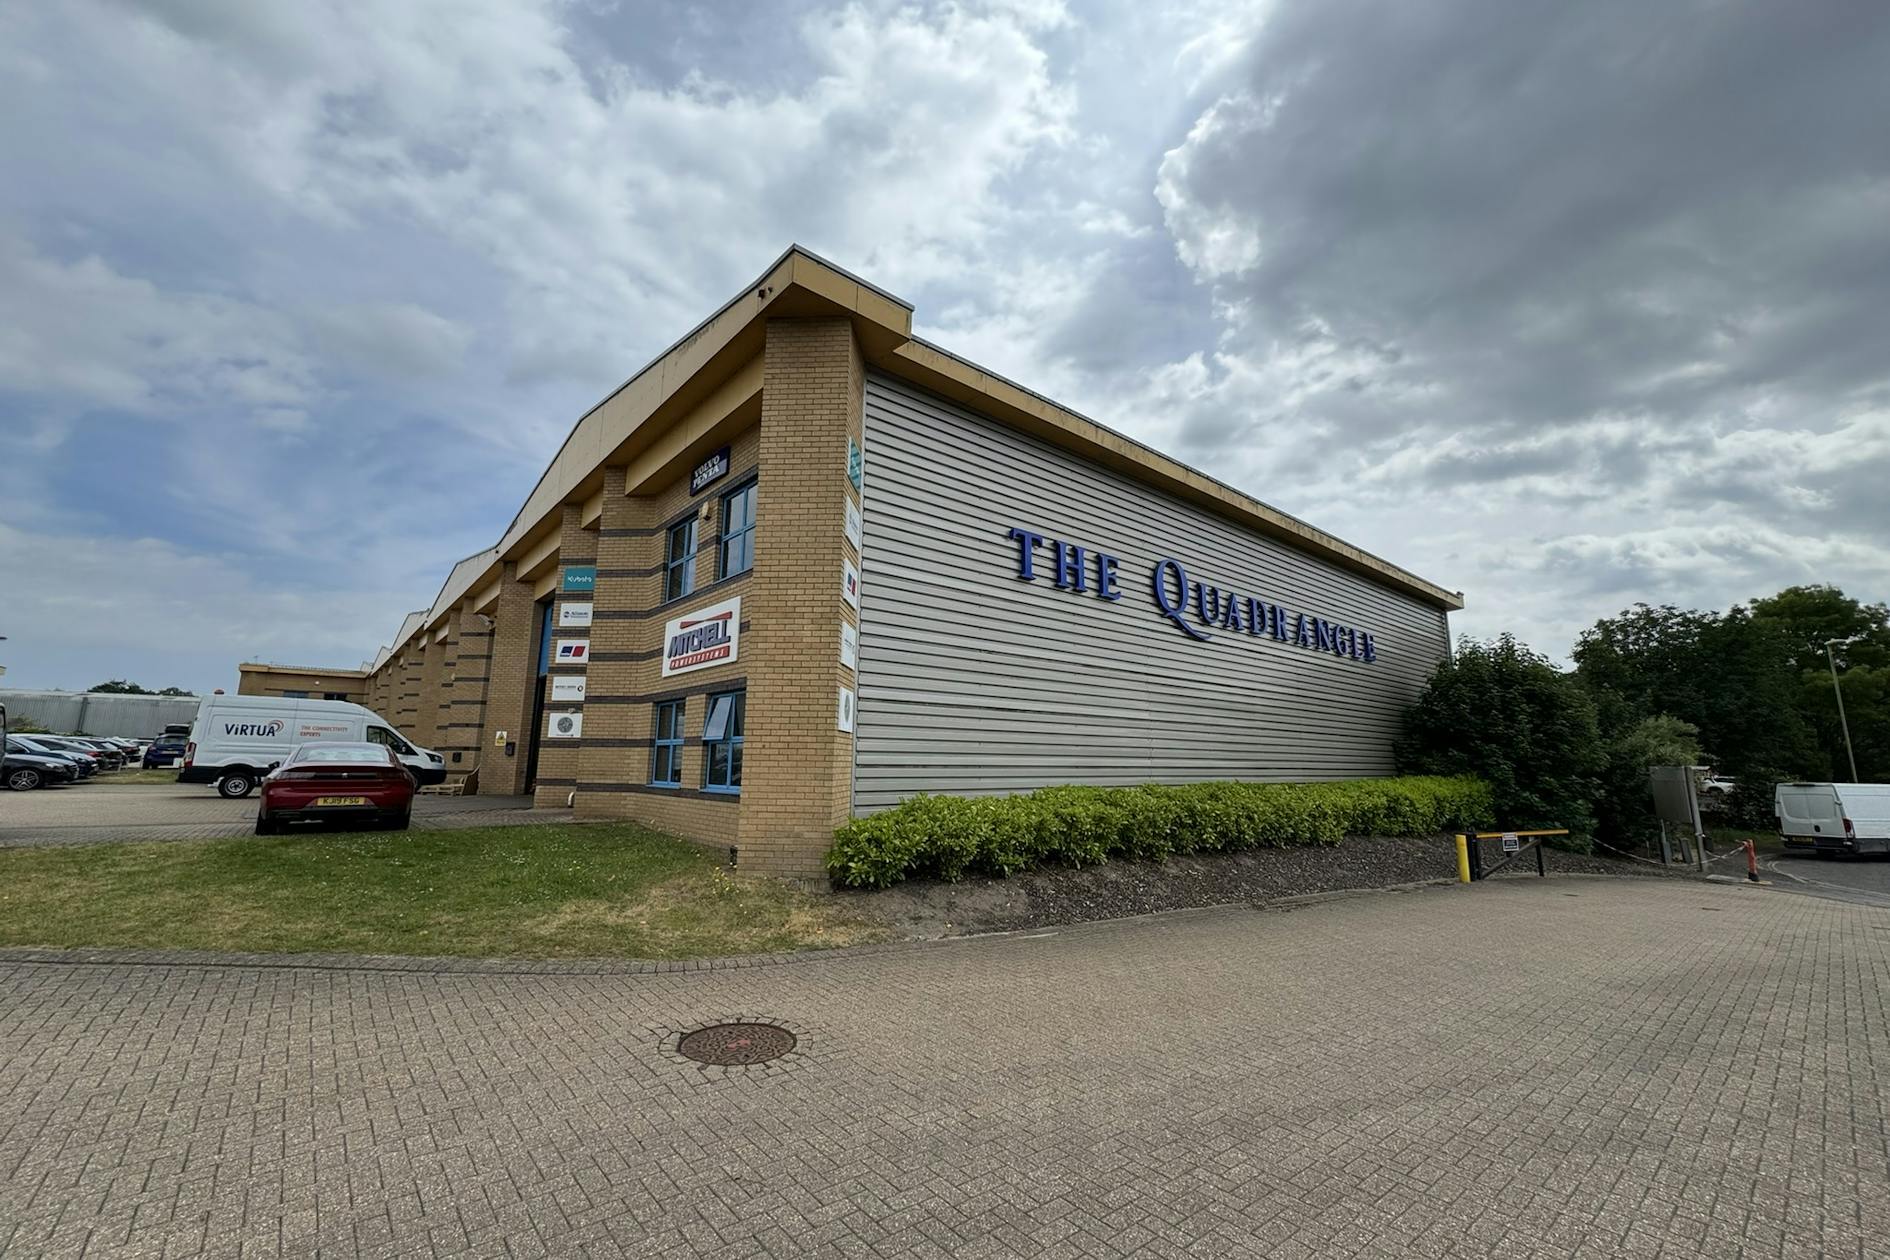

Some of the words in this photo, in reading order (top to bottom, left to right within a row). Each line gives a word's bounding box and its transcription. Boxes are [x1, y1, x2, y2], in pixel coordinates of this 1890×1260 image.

[692, 464, 720, 488] PENTA
[1007, 527, 1121, 600] THE
[1153, 557, 1376, 662] QUADRANGLE
[667, 619, 731, 659] MITCHELL
